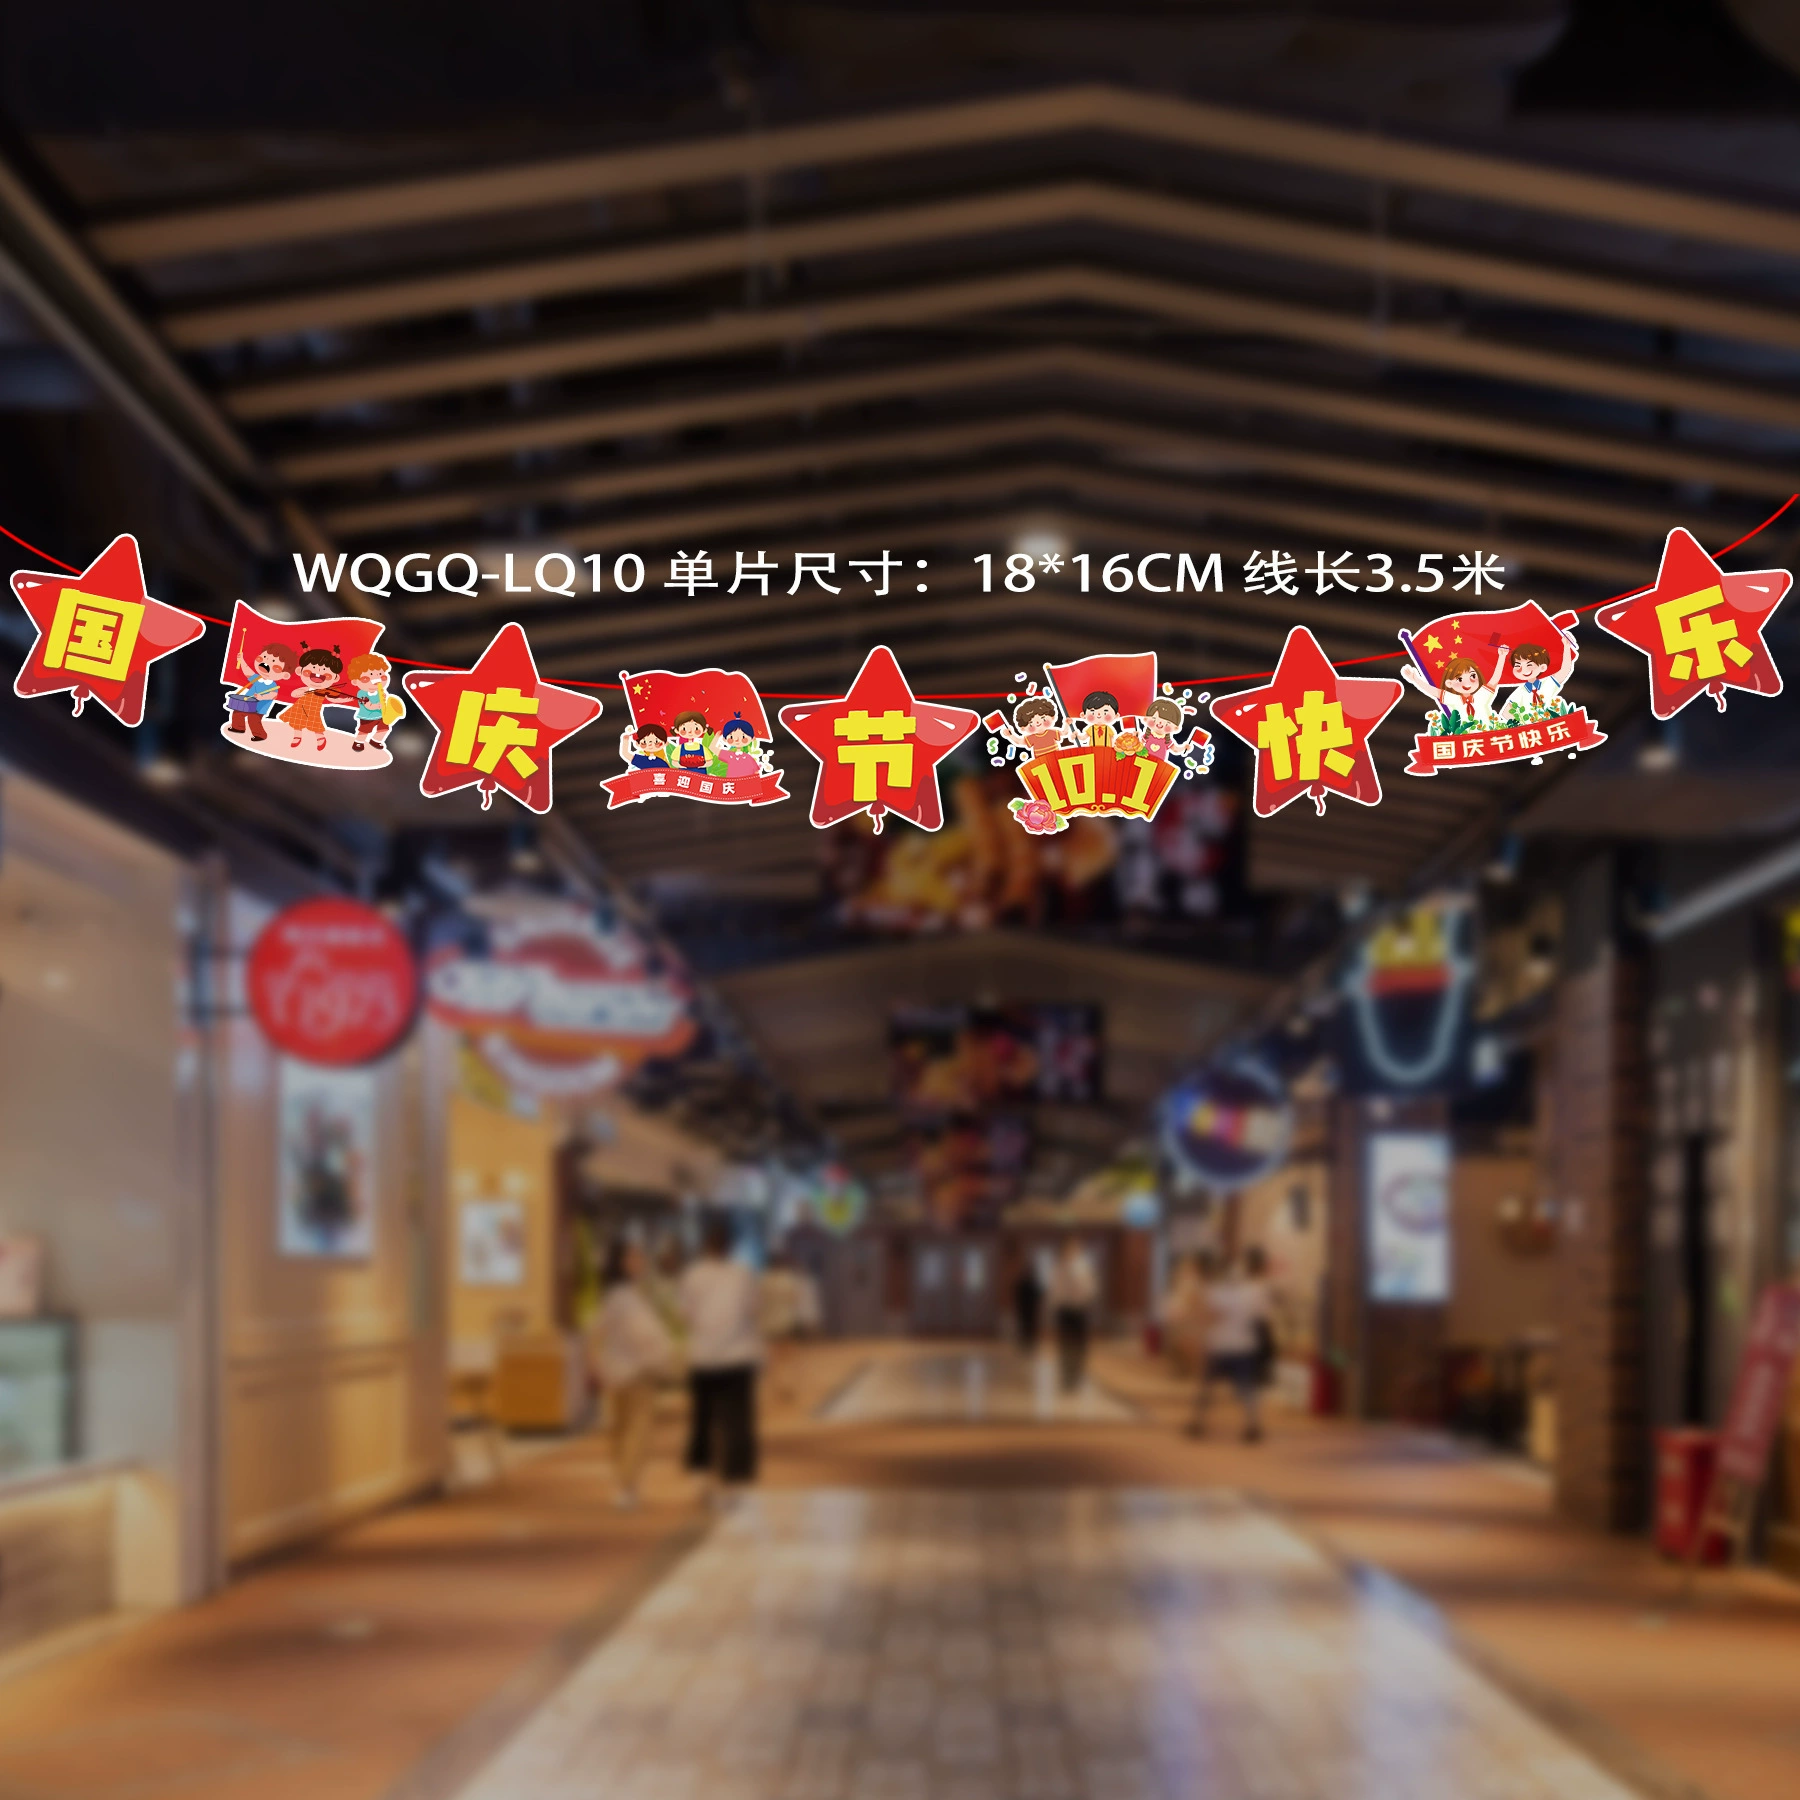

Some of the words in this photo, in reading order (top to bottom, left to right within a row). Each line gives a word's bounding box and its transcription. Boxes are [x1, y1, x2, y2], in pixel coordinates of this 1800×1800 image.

[43, 588, 146, 682] 国
[446, 687, 540, 779] 庆
[834, 710, 917, 802] 节
[1257, 690, 1355, 781] 快
[1655, 585, 1753, 680] 乐
[1432, 720, 1572, 760] 国庆节快乐
[652, 772, 736, 796] 喜迎国庆
[1030, 753, 1158, 813] 10.1
